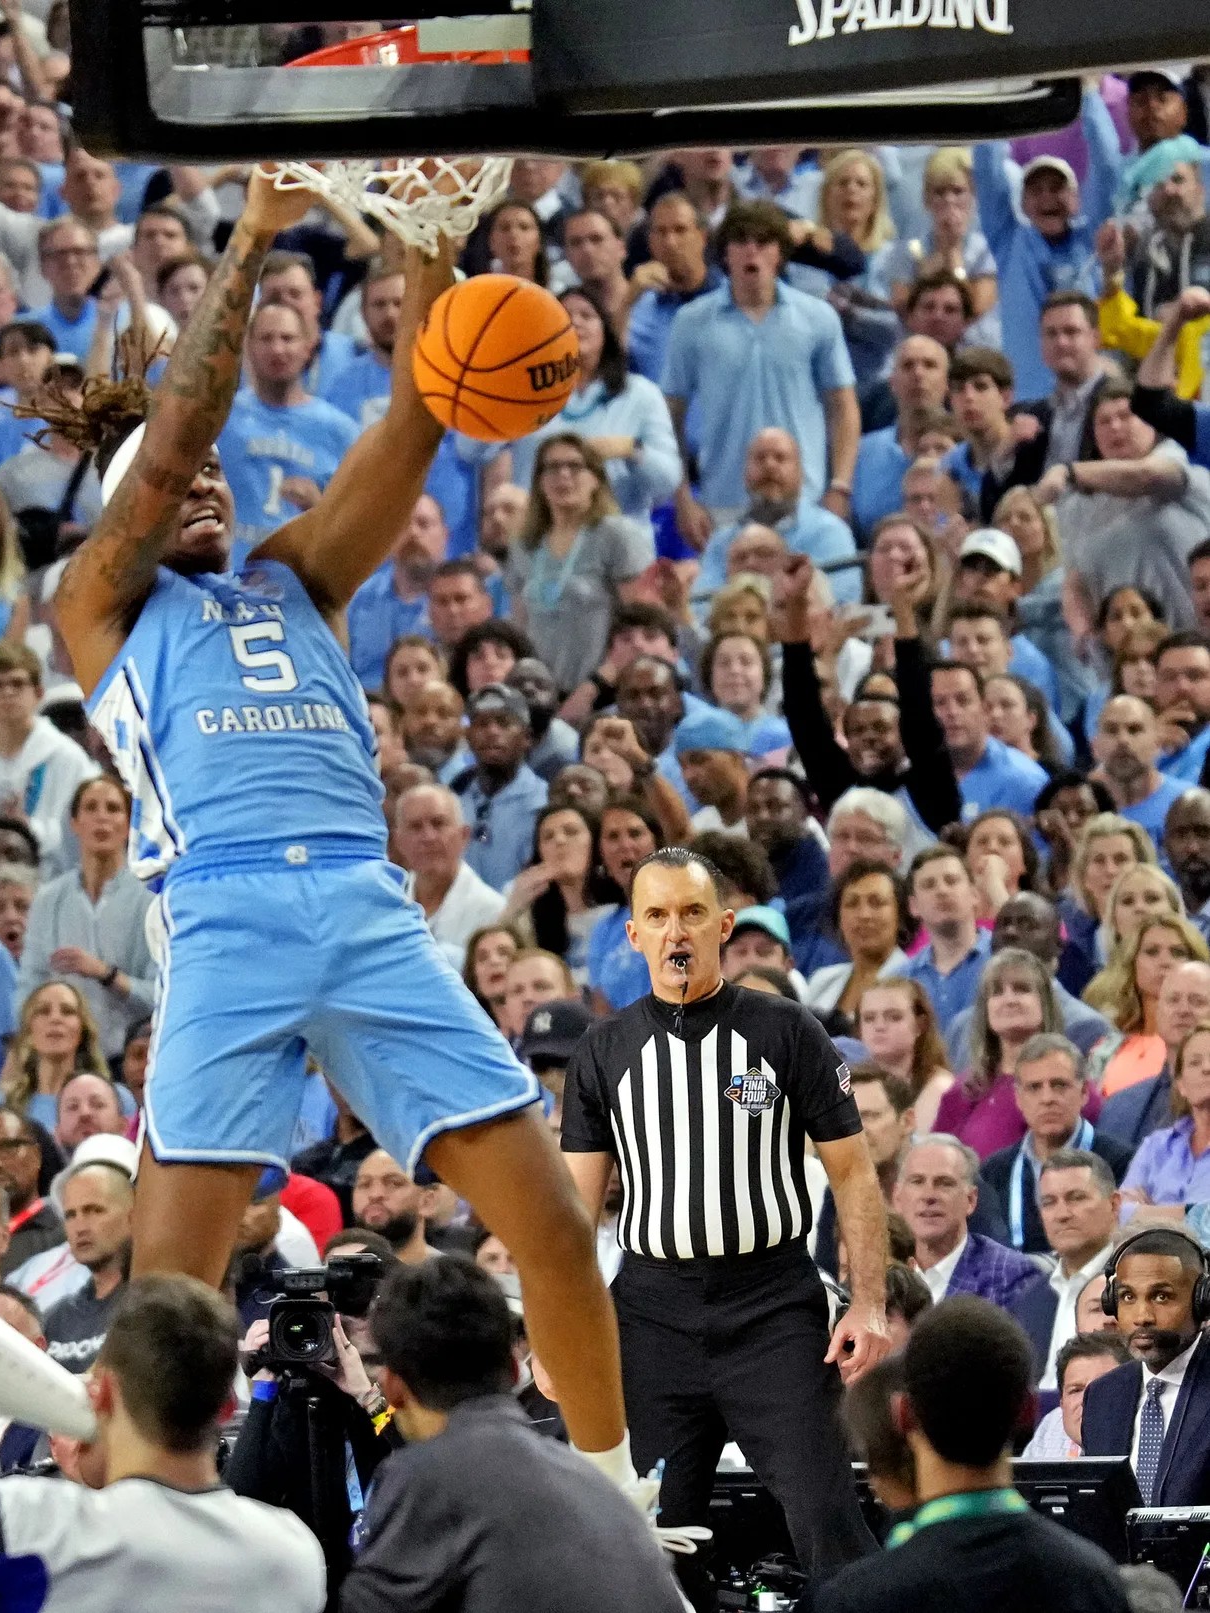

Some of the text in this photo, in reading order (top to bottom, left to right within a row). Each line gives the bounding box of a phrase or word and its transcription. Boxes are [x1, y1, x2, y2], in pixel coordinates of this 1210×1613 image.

[788, 0, 1015, 46] SPALDING
[228, 620, 299, 691] 5
[197, 703, 350, 735] CAROLINA
[741, 1091, 767, 1102] FOUR
[742, 1080, 768, 1091] FINAL
